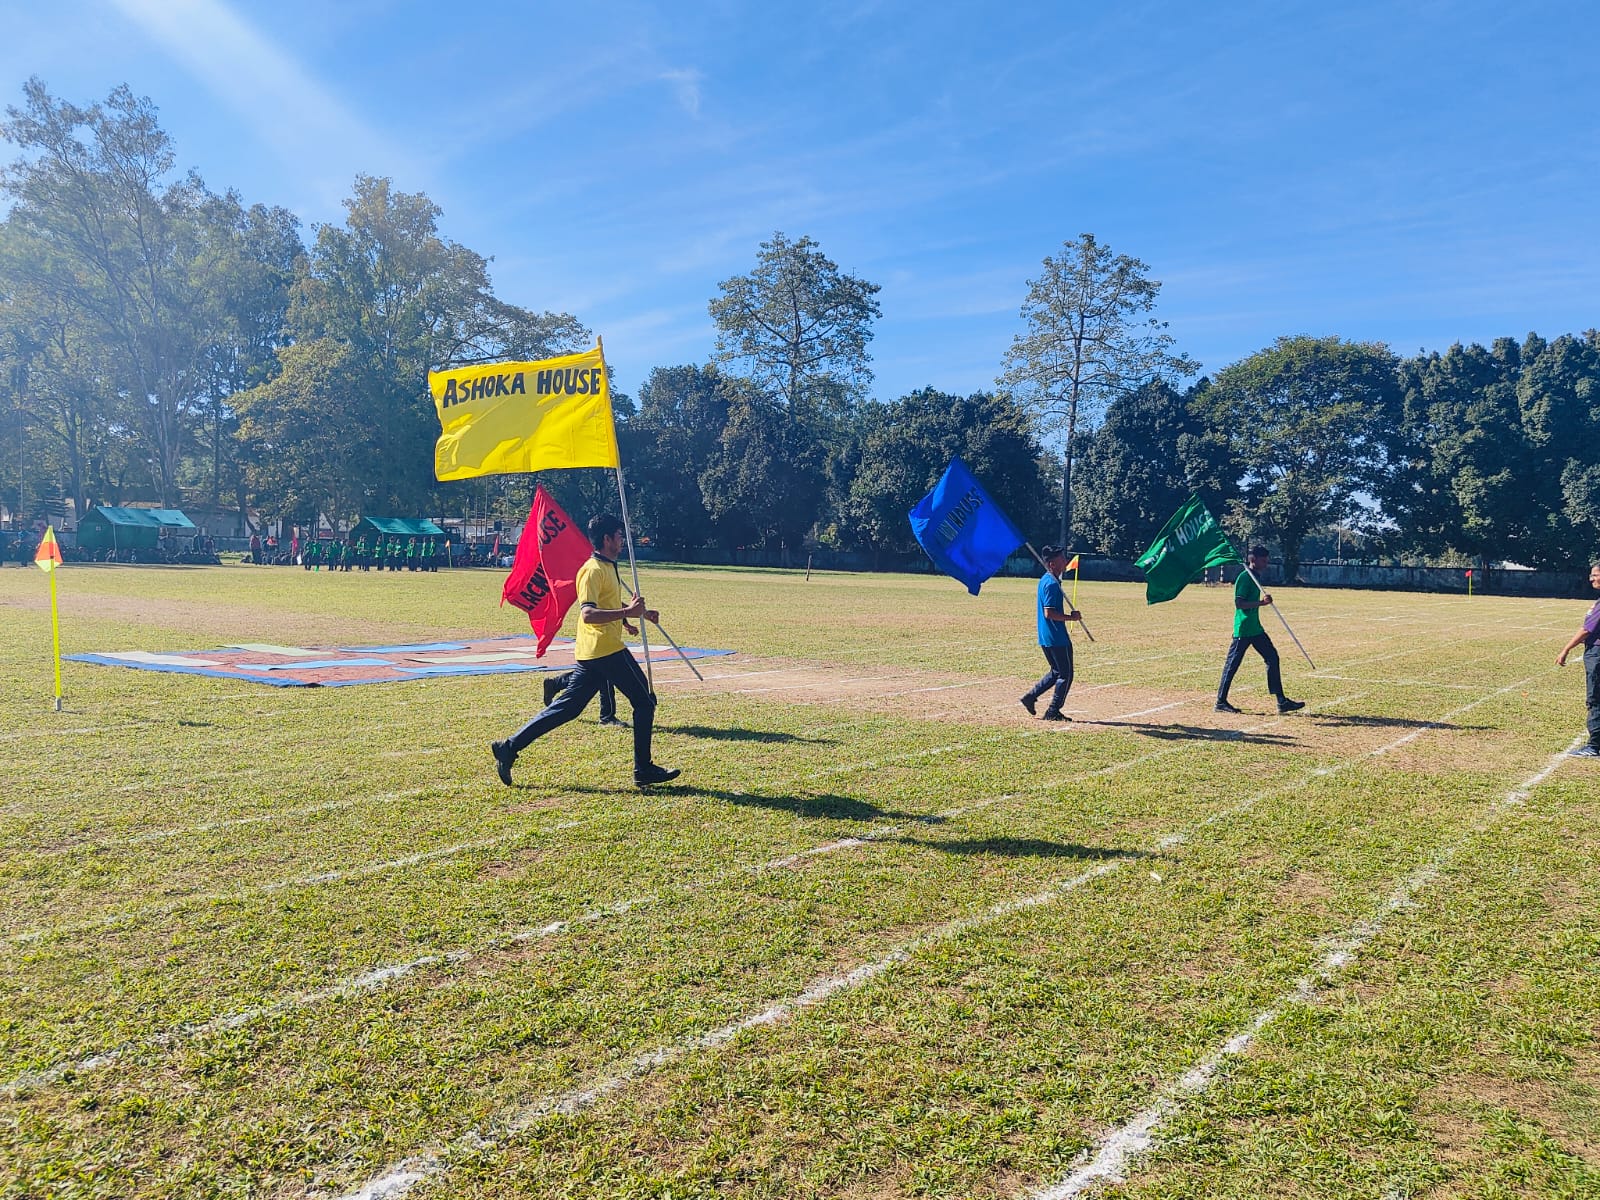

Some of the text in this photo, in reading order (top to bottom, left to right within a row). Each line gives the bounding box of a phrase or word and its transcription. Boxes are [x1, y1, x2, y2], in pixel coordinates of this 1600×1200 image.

[444, 368, 601, 407] ASHOKA HOUSE
[540, 509, 566, 546] USE
